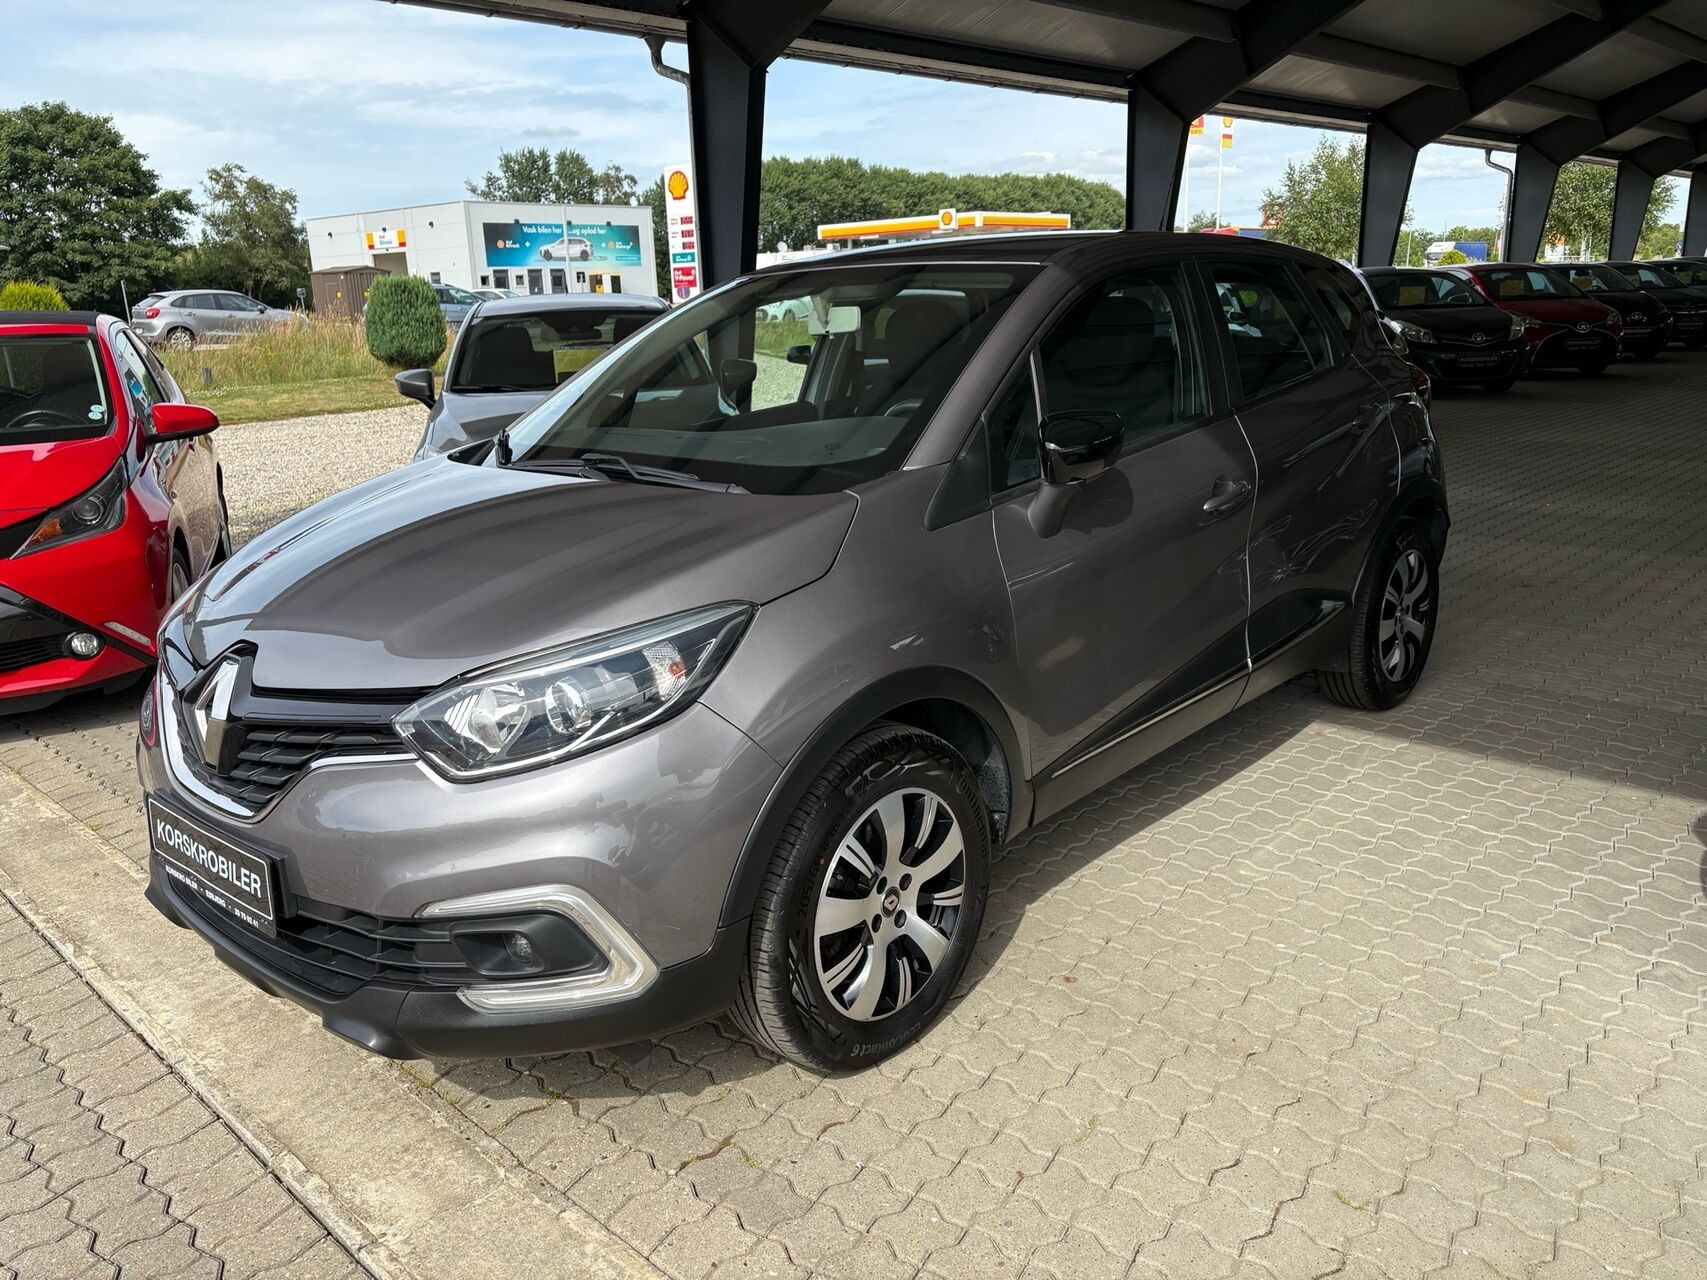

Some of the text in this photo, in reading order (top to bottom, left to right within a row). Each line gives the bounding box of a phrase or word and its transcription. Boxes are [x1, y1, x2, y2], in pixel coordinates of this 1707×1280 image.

[522, 225, 562, 234] Vask bilen her
[597, 227, 607, 235] her
[156, 819, 262, 898] KORSKROBILER
